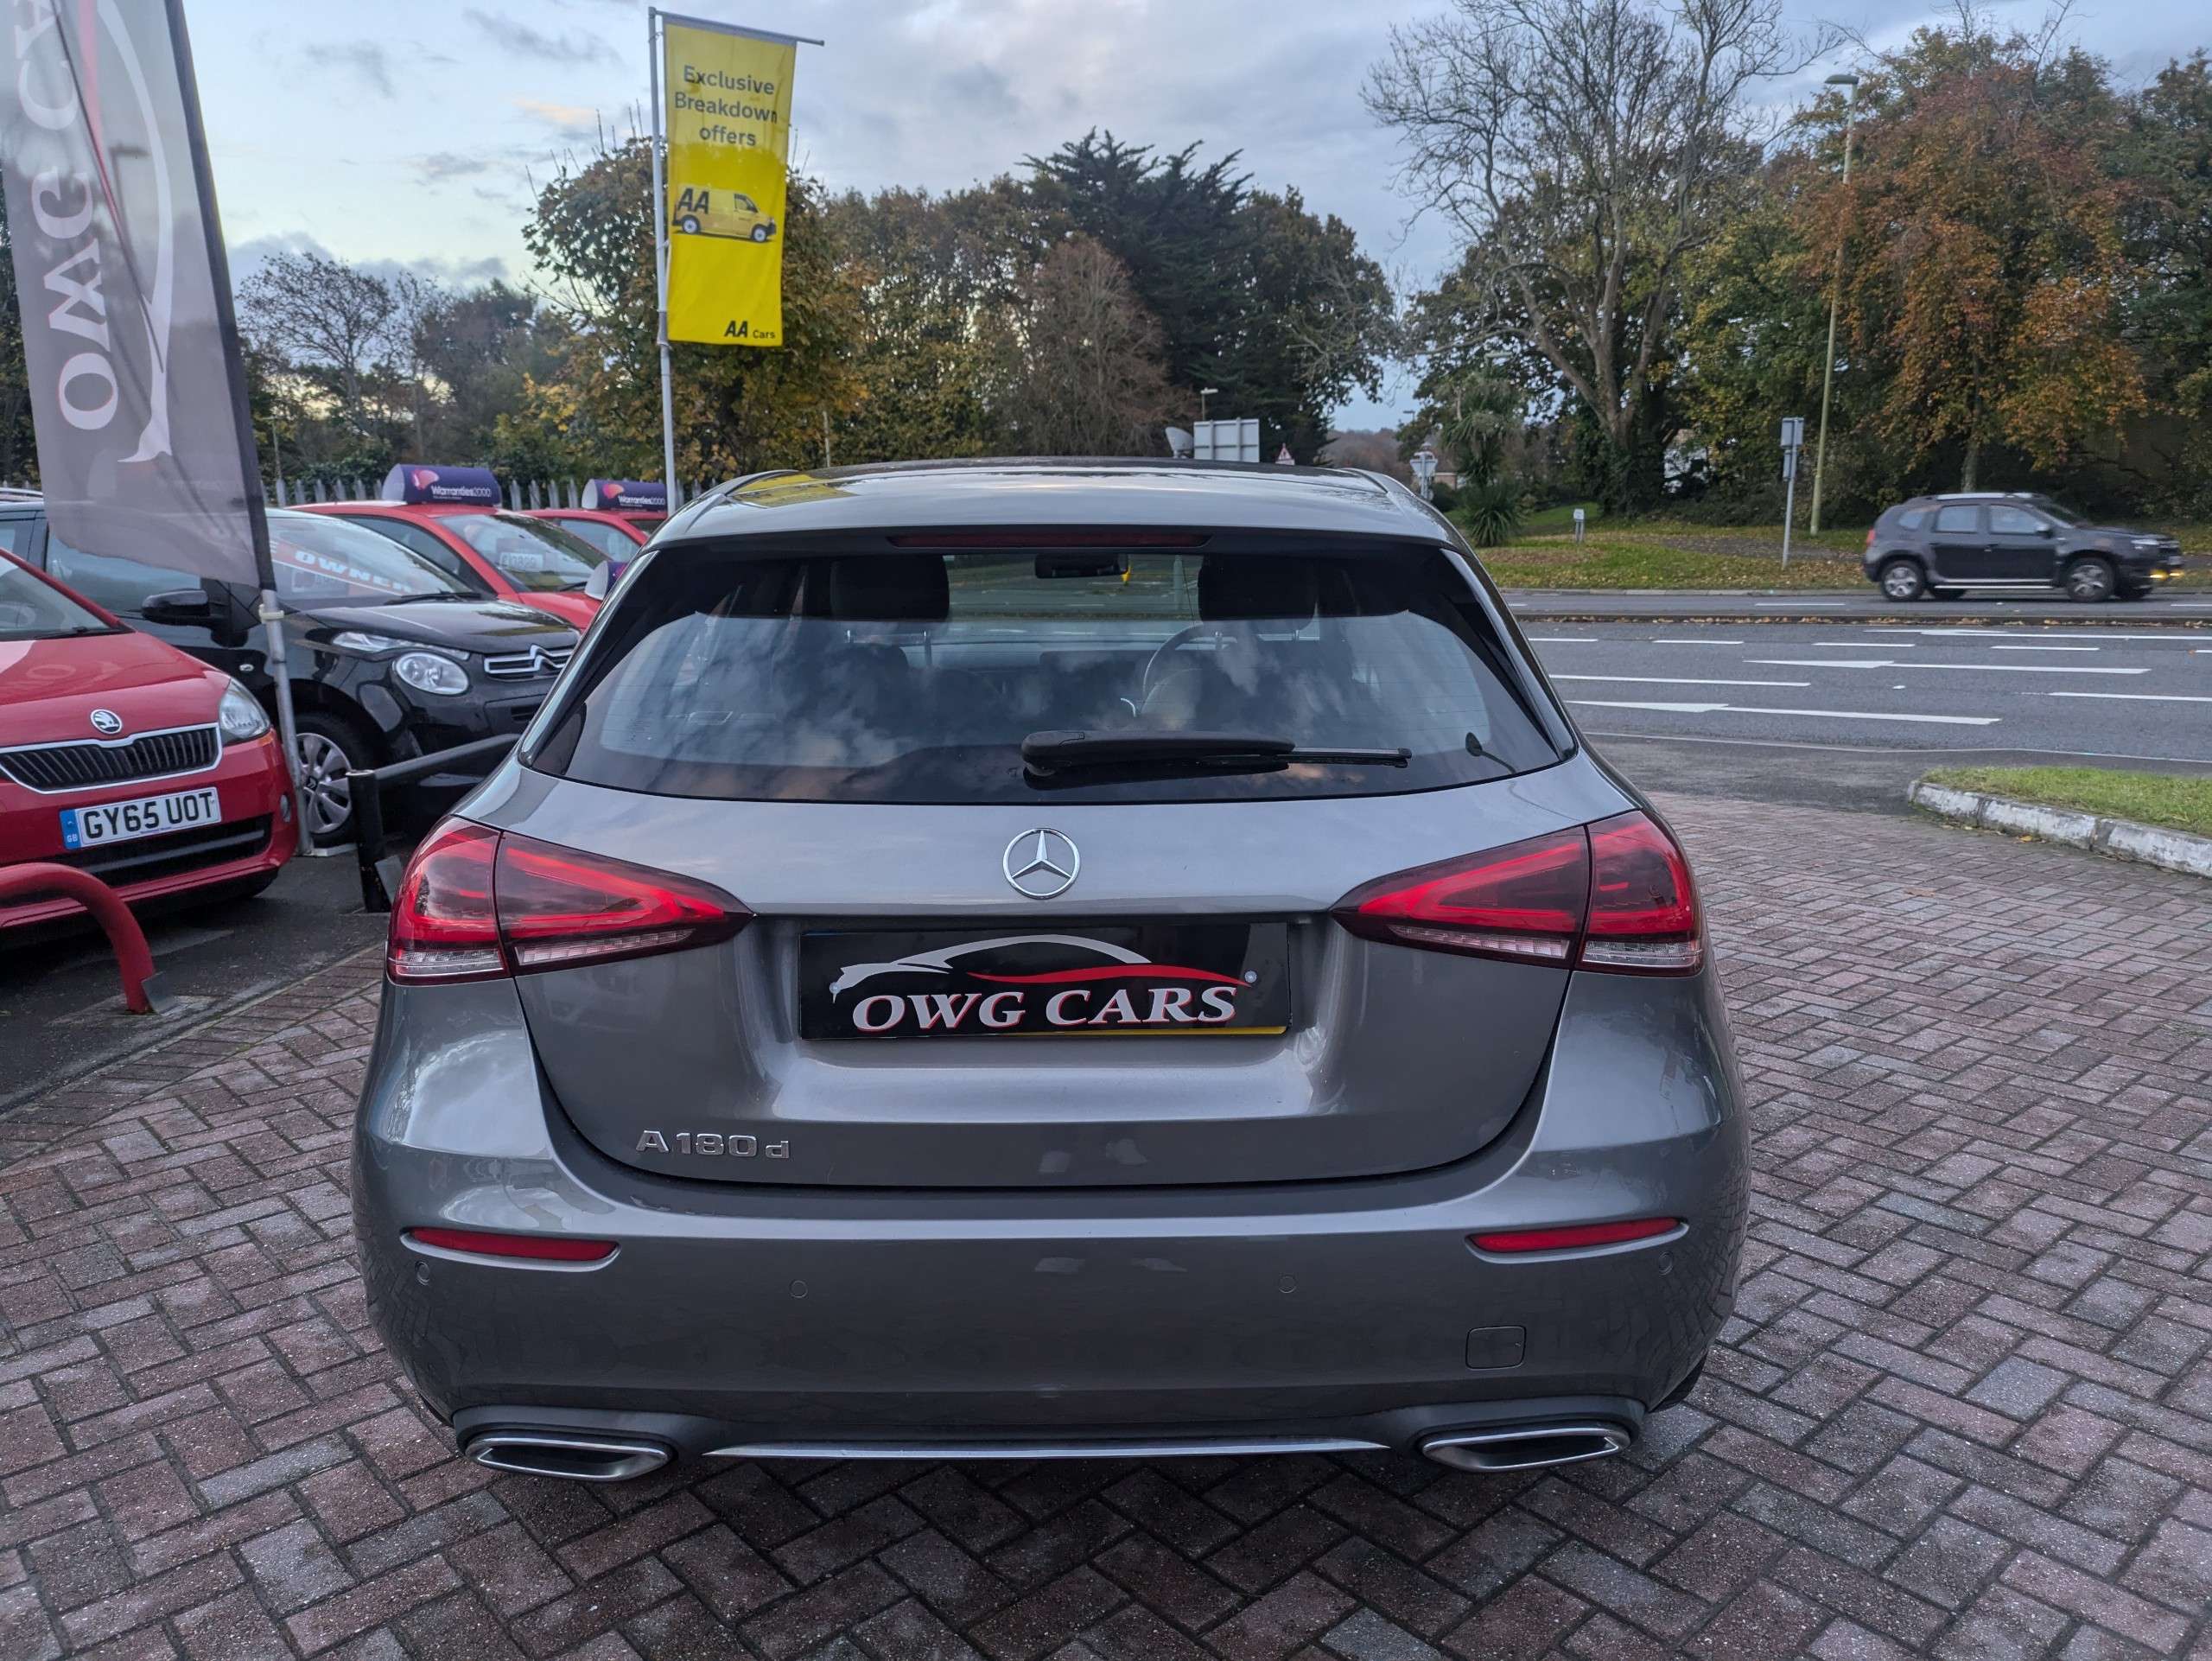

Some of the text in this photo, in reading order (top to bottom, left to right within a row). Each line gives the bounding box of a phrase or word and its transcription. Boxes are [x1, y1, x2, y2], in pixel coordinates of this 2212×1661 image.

[683, 65, 775, 95] Exclusive
[675, 92, 778, 124] Breakdown
[699, 124, 757, 146] offers
[677, 188, 709, 215] AA
[724, 320, 776, 339] AA Cars
[84, 792, 213, 839] GY65 UOT
[67, 834, 78, 843] GB
[852, 986, 1238, 1031] OWG CARS
